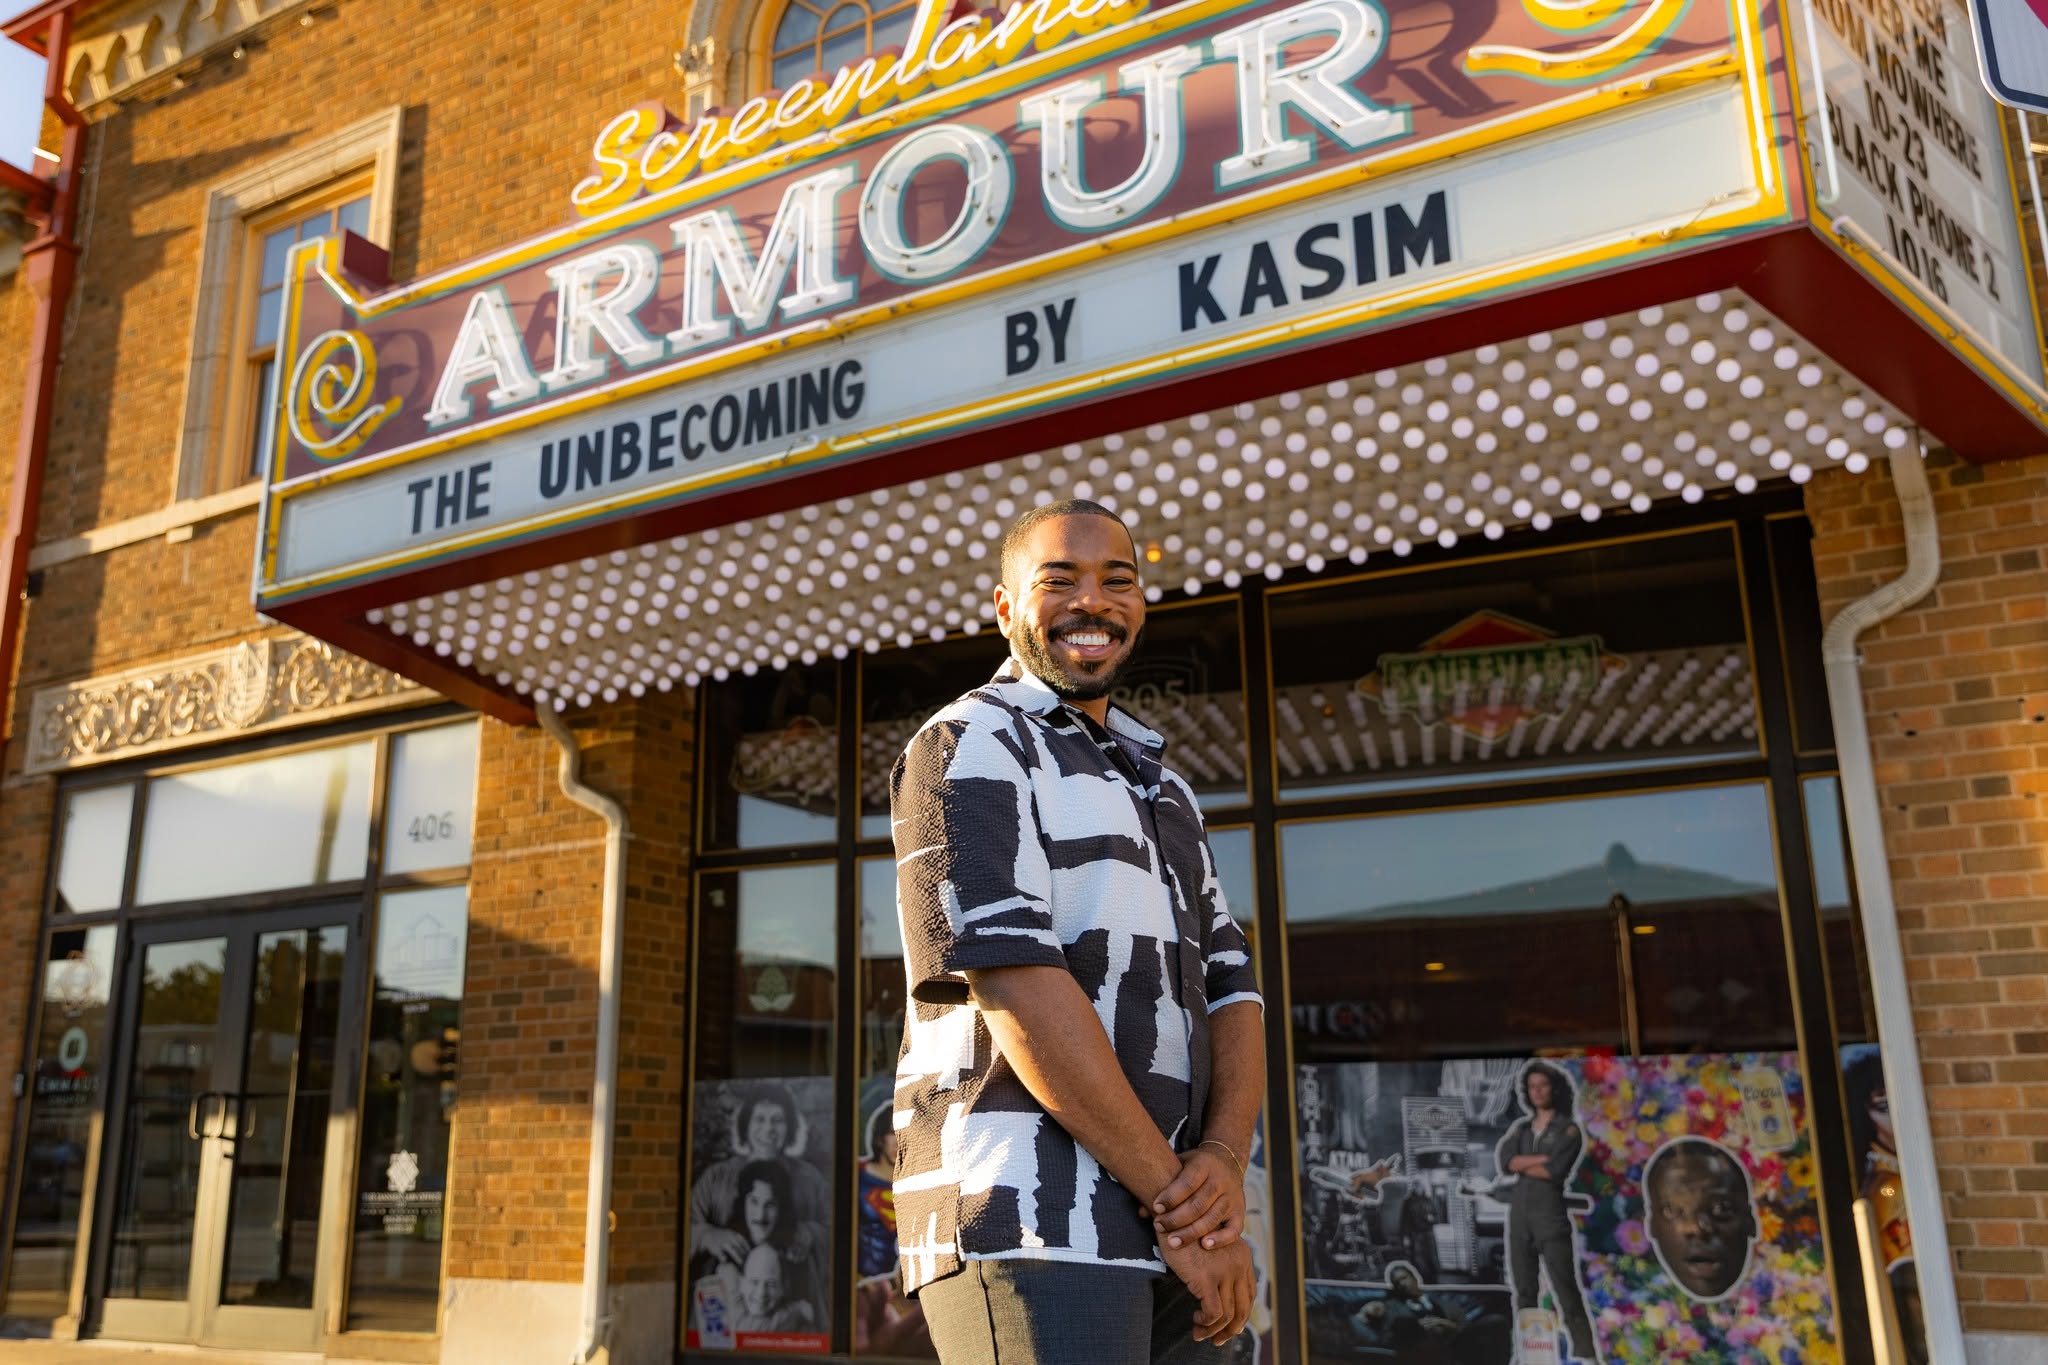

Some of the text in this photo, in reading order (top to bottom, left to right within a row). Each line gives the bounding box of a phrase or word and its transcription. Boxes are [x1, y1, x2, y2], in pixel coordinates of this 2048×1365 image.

[1825, 91, 1905, 214] BLACK
[1983, 251, 2000, 301] 2
[1864, 79, 1928, 180] 10-23
[1875, 42, 1982, 182] NOWHERE
[422, 0, 1411, 428] ARMOUR
[407, 190, 1453, 535] THE UNBECOMING BY KASIM
[407, 811, 457, 843] 406
